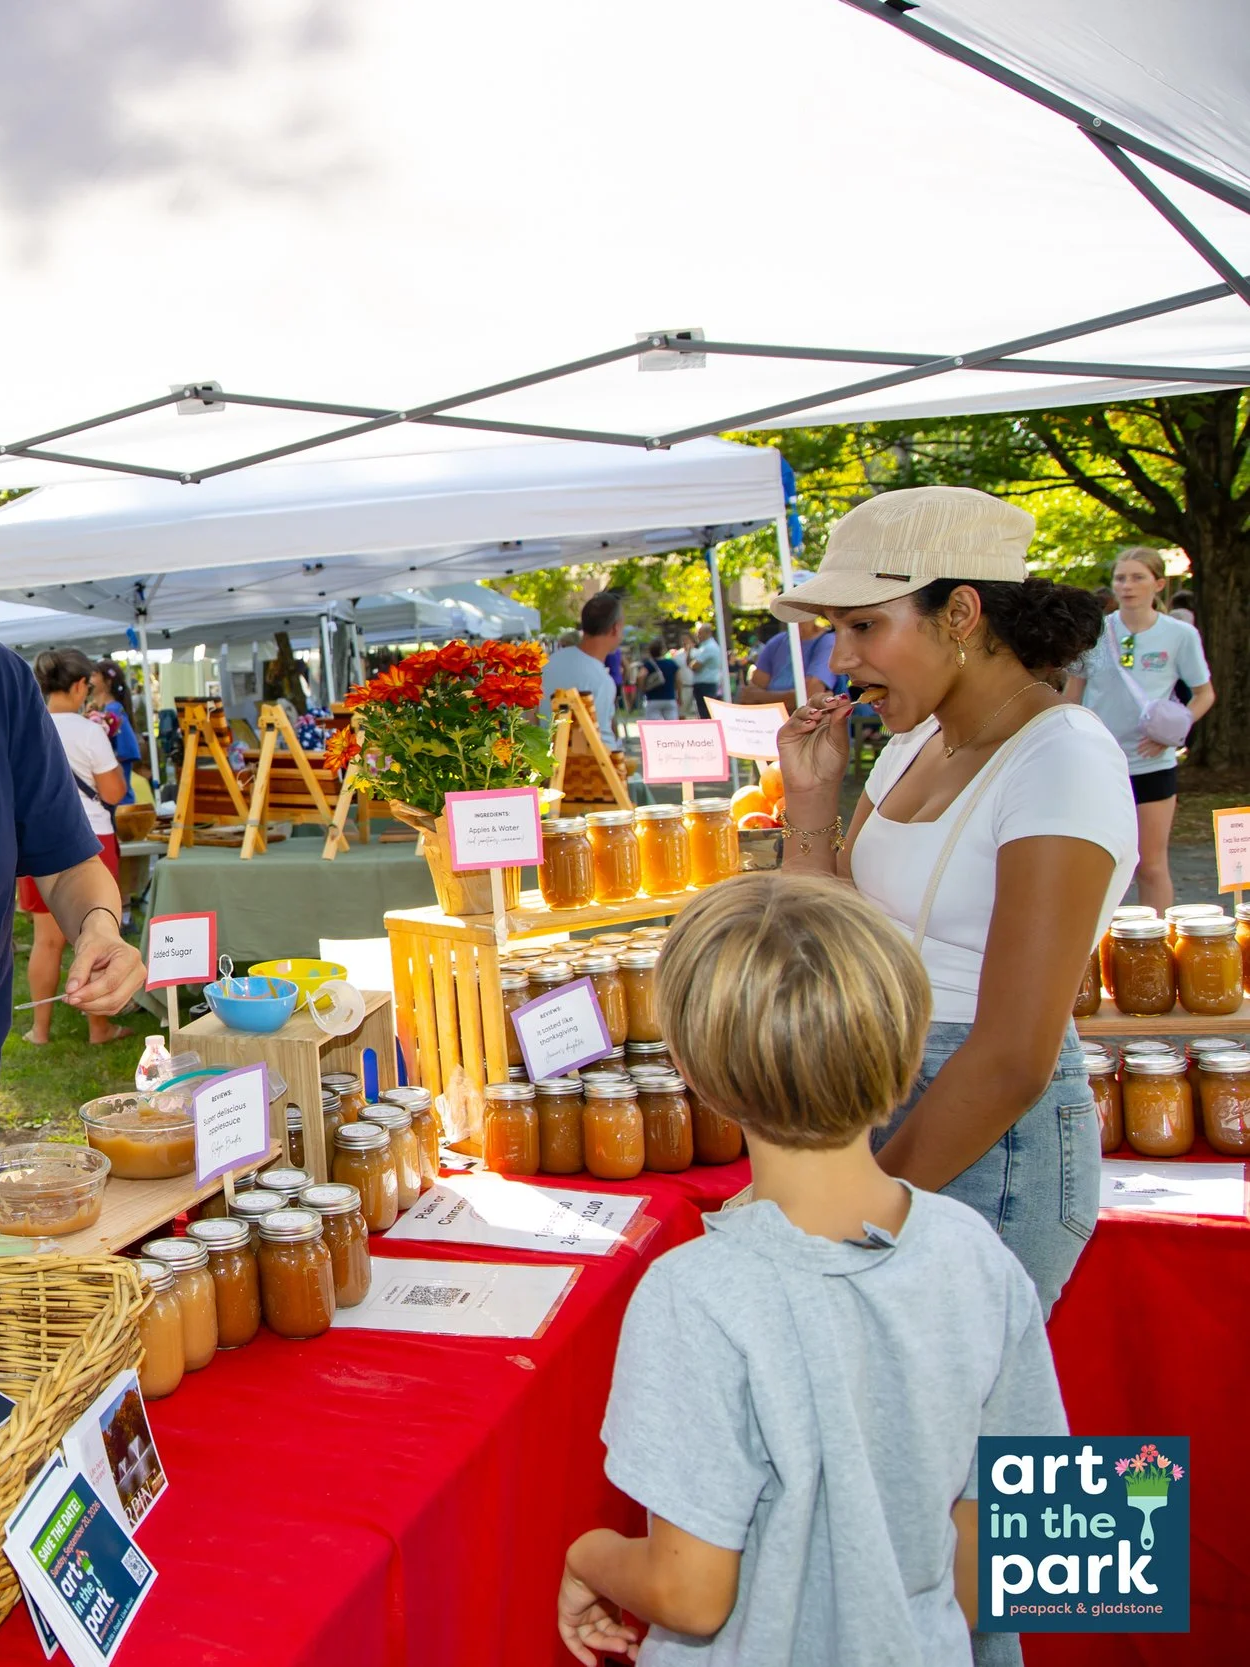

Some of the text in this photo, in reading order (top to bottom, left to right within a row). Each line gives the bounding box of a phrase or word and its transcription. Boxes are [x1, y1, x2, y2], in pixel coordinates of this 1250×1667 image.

[657, 739, 714, 749] Family Made!
[469, 826, 490, 834] Apples
[164, 935, 174, 943] No
[171, 948, 192, 958] Sugar
[542, 1015, 574, 1034] tasted like
[539, 1024, 579, 1046] thanksgiving
[212, 1089, 232, 1102] REVIEWS:
[209, 1117, 241, 1136] applesauce
[415, 1202, 439, 1219] Plain
[38, 1498, 82, 1563] SAVE THE DATE!
[50, 1555, 67, 1578] Sunday,
[63, 1525, 85, 1557] September
[88, 1500, 101, 1519] 2026
[61, 1561, 83, 1598] art
[71, 1582, 95, 1616] in the
[85, 1587, 115, 1644] park
